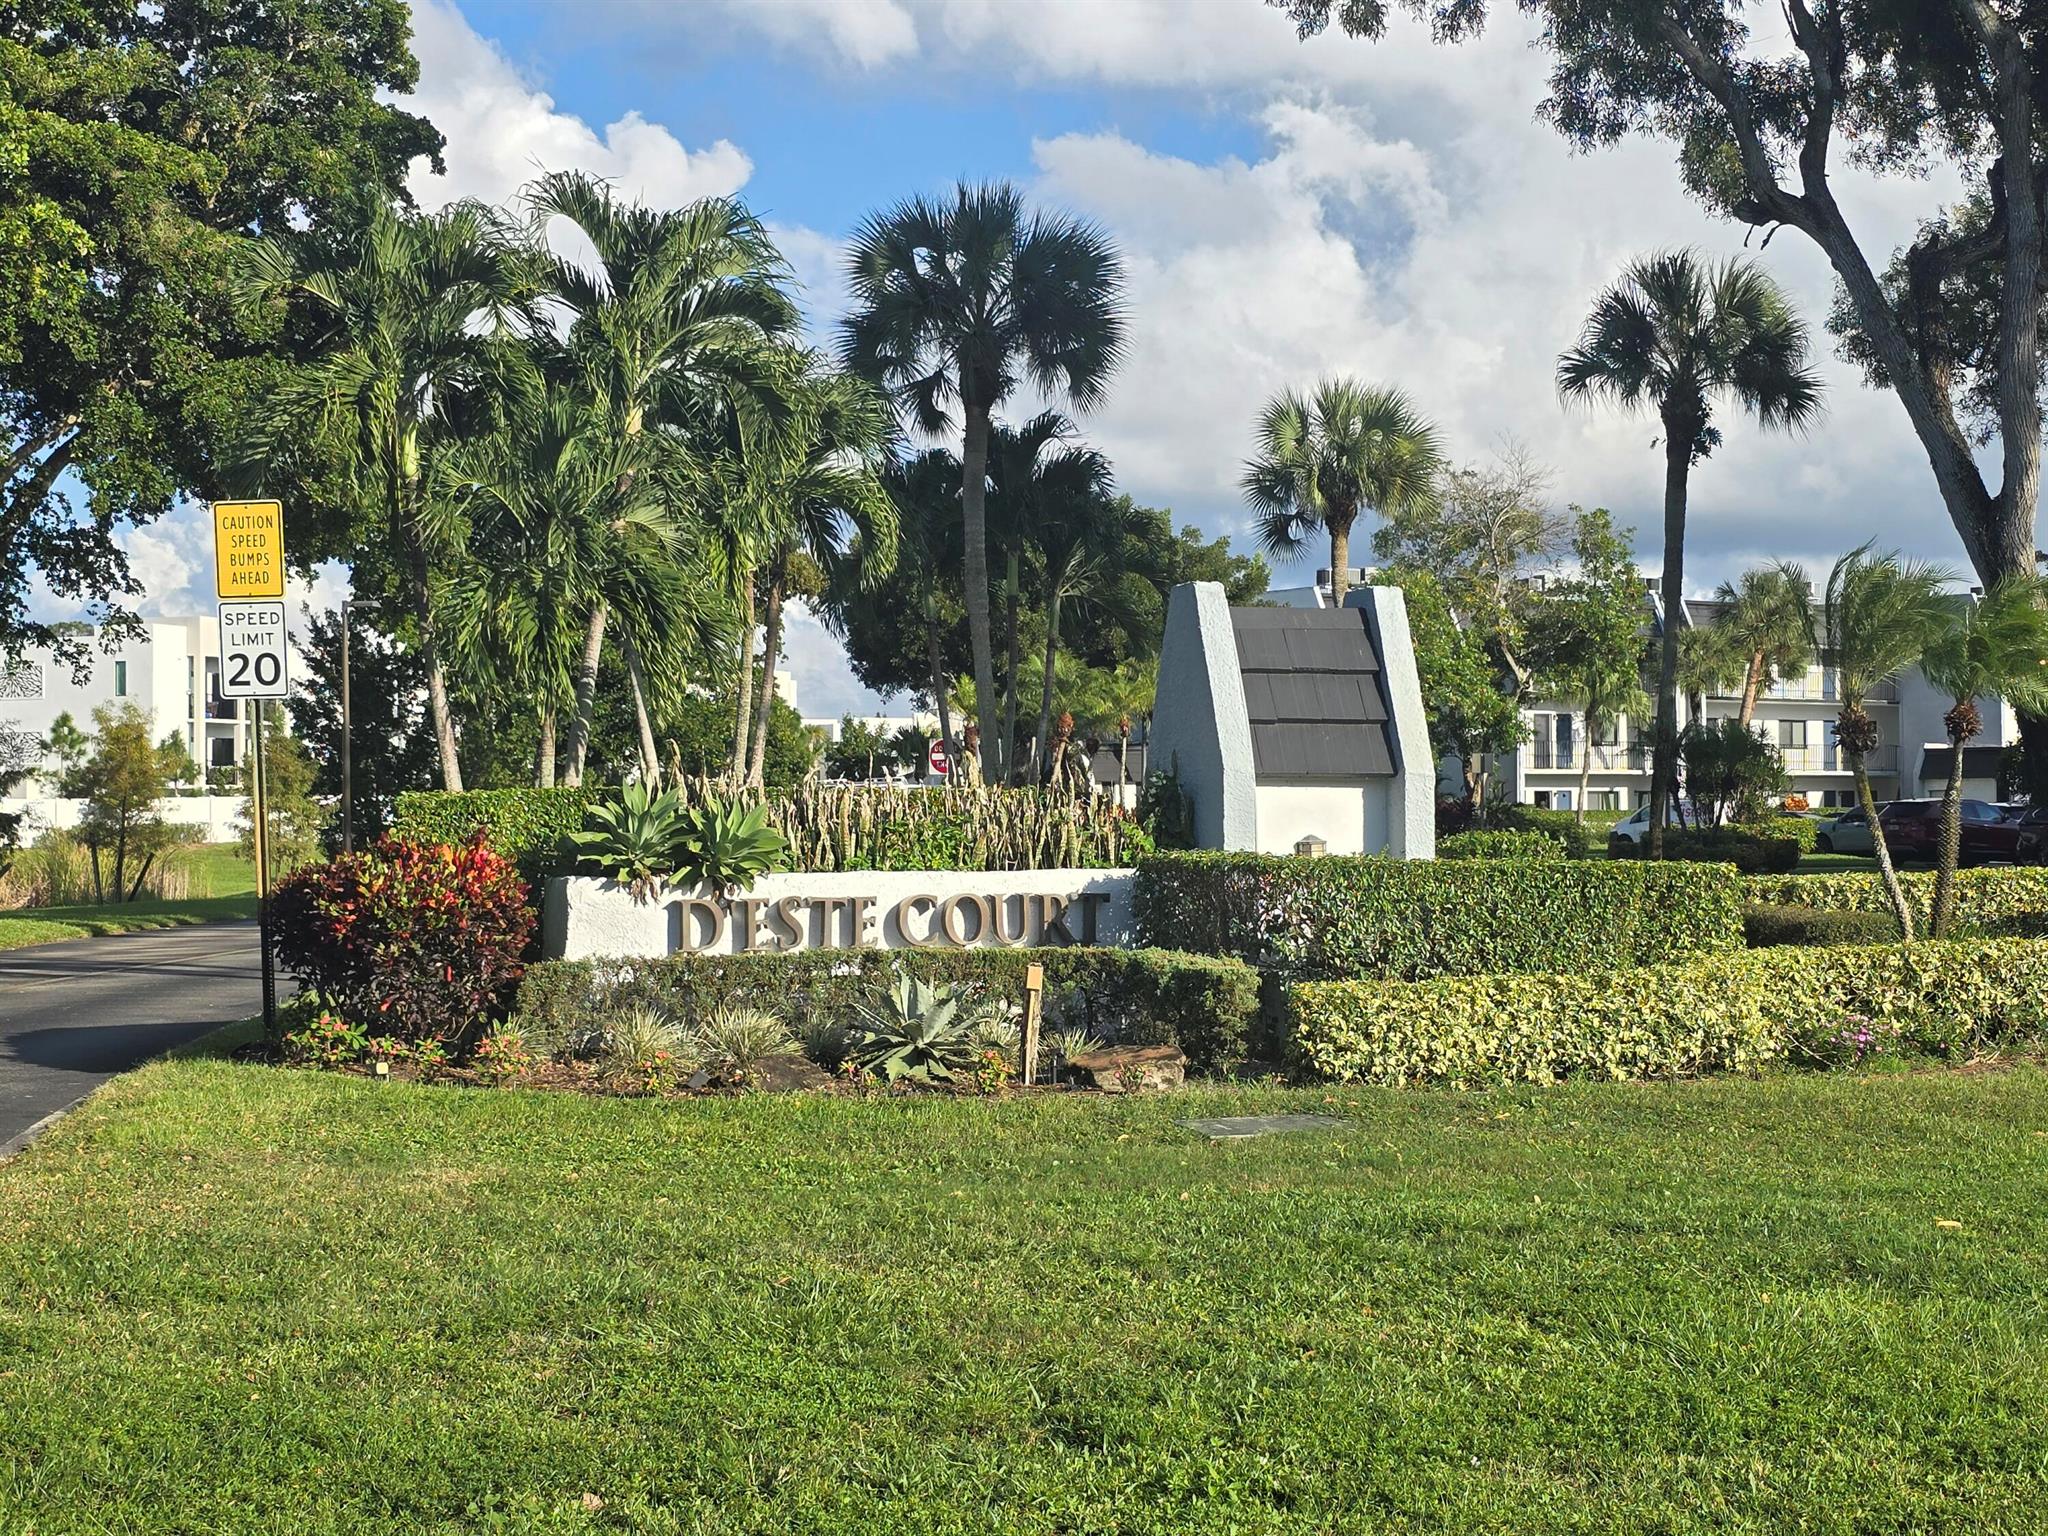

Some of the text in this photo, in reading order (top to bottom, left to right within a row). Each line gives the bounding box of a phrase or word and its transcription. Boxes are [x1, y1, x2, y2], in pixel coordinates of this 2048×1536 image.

[223, 515, 273, 530] CAUTION
[231, 534, 266, 548] SPEED
[230, 552, 270, 567] BUMPS
[231, 571, 270, 585] AHEAD
[225, 612, 280, 626] SPEED
[231, 632, 274, 646] LIMIT
[228, 652, 281, 687] 20
[895, 892, 1111, 948] COURT
